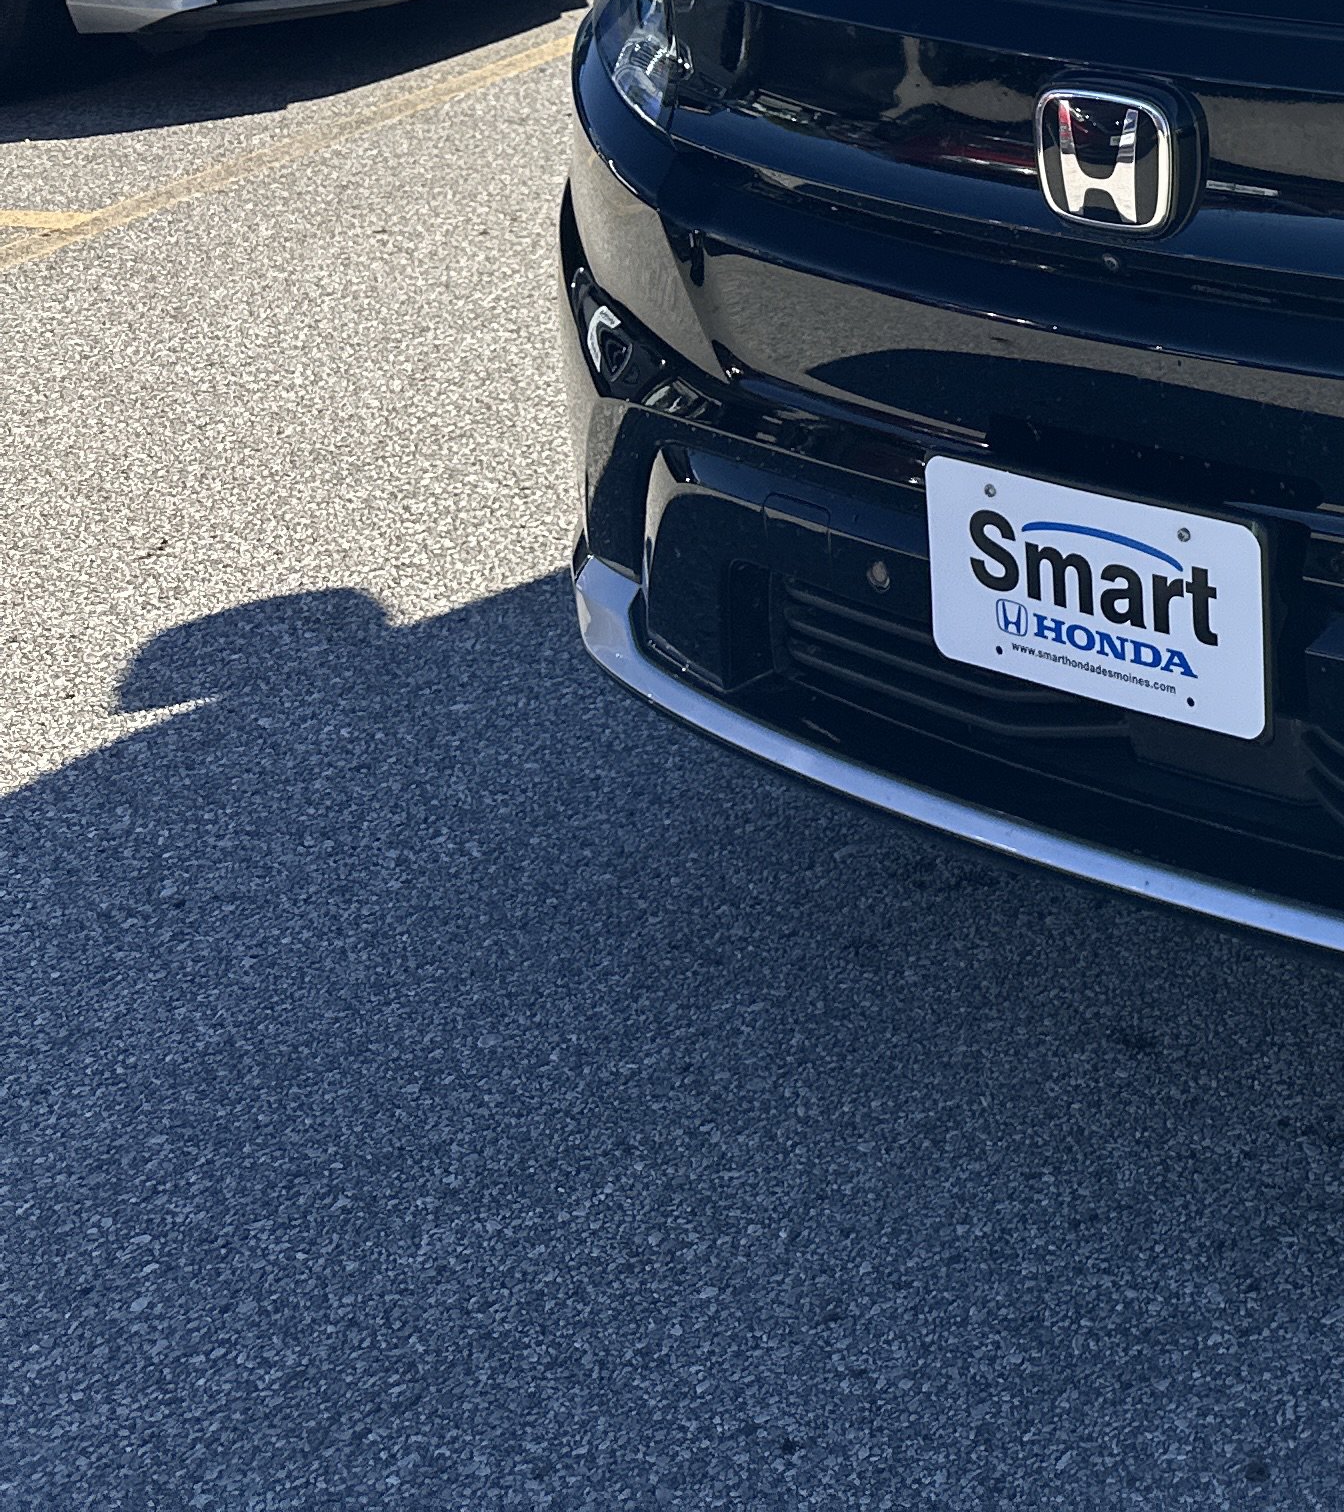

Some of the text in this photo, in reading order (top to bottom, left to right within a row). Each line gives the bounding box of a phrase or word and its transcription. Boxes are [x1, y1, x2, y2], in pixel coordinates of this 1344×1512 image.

[969, 509, 1219, 647] Smart
[1011, 641, 1178, 695] www.smarthondadesmoines.com
[1033, 612, 1199, 679] HONDA
